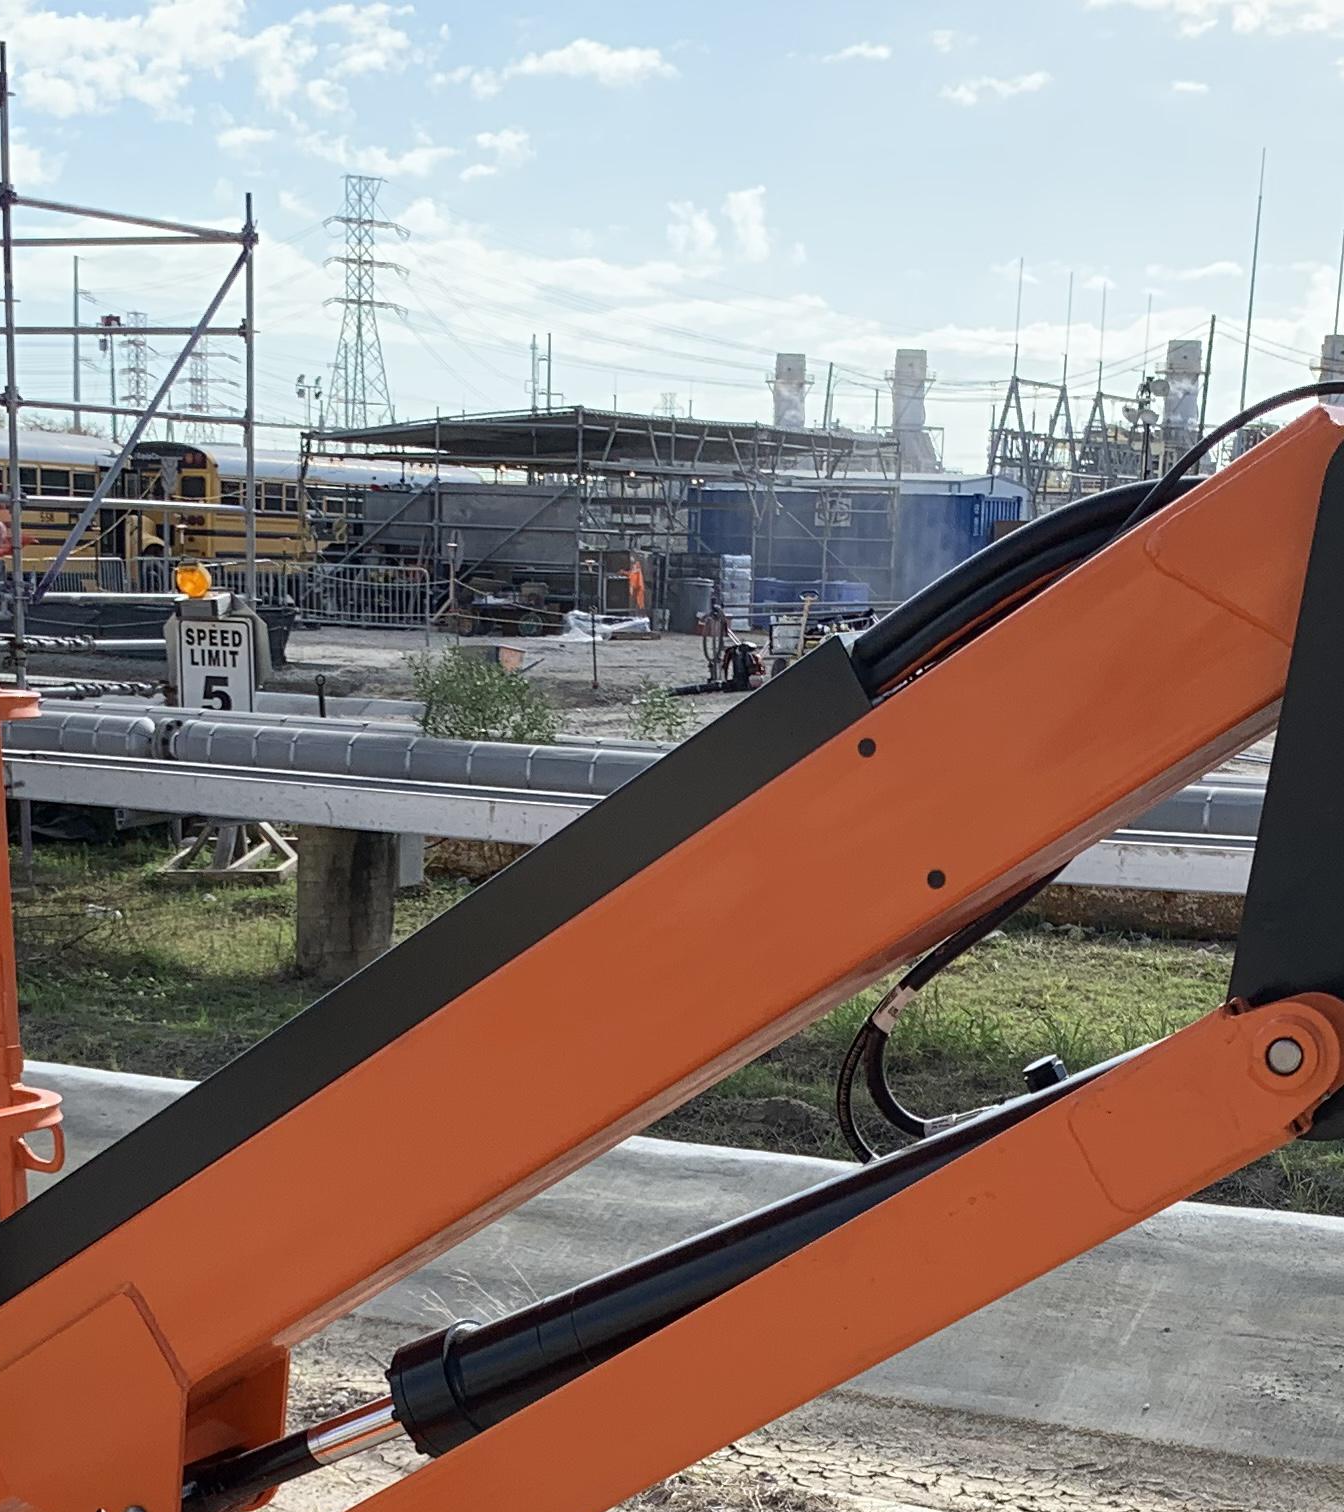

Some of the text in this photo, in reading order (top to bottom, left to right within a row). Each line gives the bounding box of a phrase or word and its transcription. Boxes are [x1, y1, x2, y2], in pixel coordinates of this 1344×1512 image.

[185, 628, 243, 647] SPEED
[190, 649, 239, 668] LIMIT
[202, 675, 232, 711] 5
